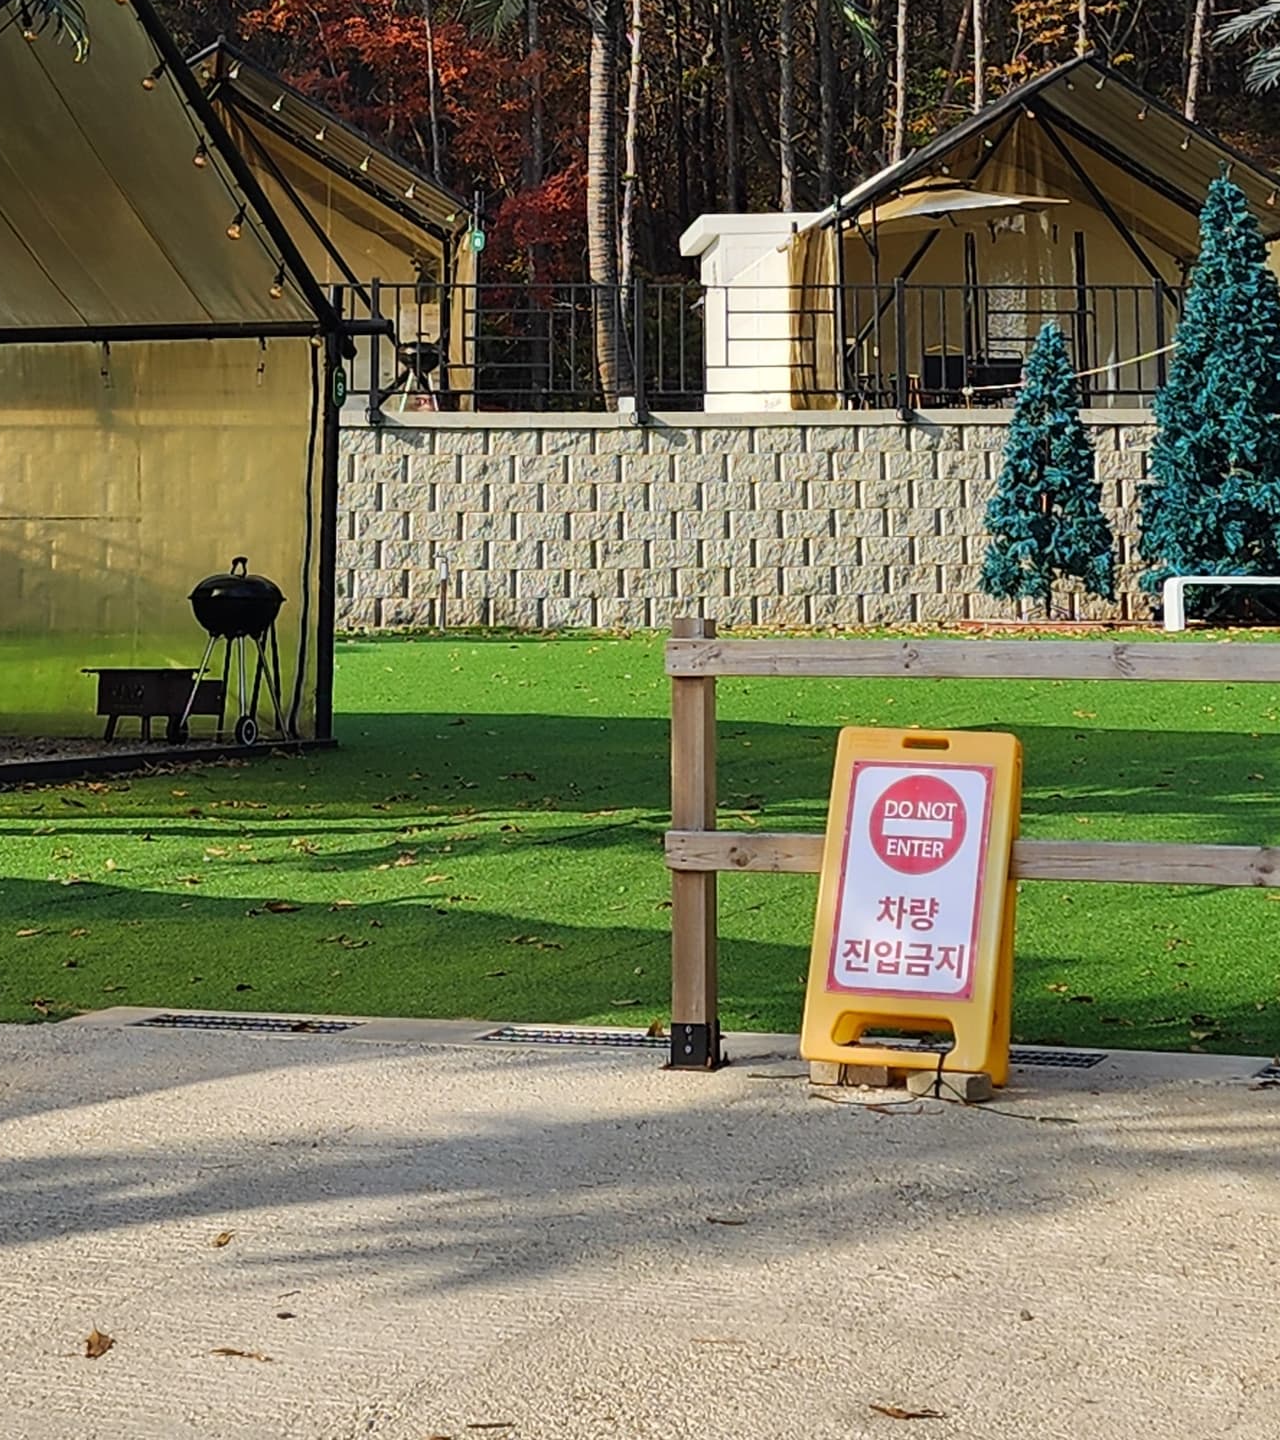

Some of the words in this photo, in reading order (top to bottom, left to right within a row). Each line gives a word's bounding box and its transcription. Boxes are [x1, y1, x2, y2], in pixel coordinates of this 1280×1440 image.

[884, 799, 914, 818] DO
[917, 801, 958, 820] NOT
[886, 838, 944, 859] ENTER
[876, 895, 940, 932] 차량
[842, 939, 966, 980] 진입금지
